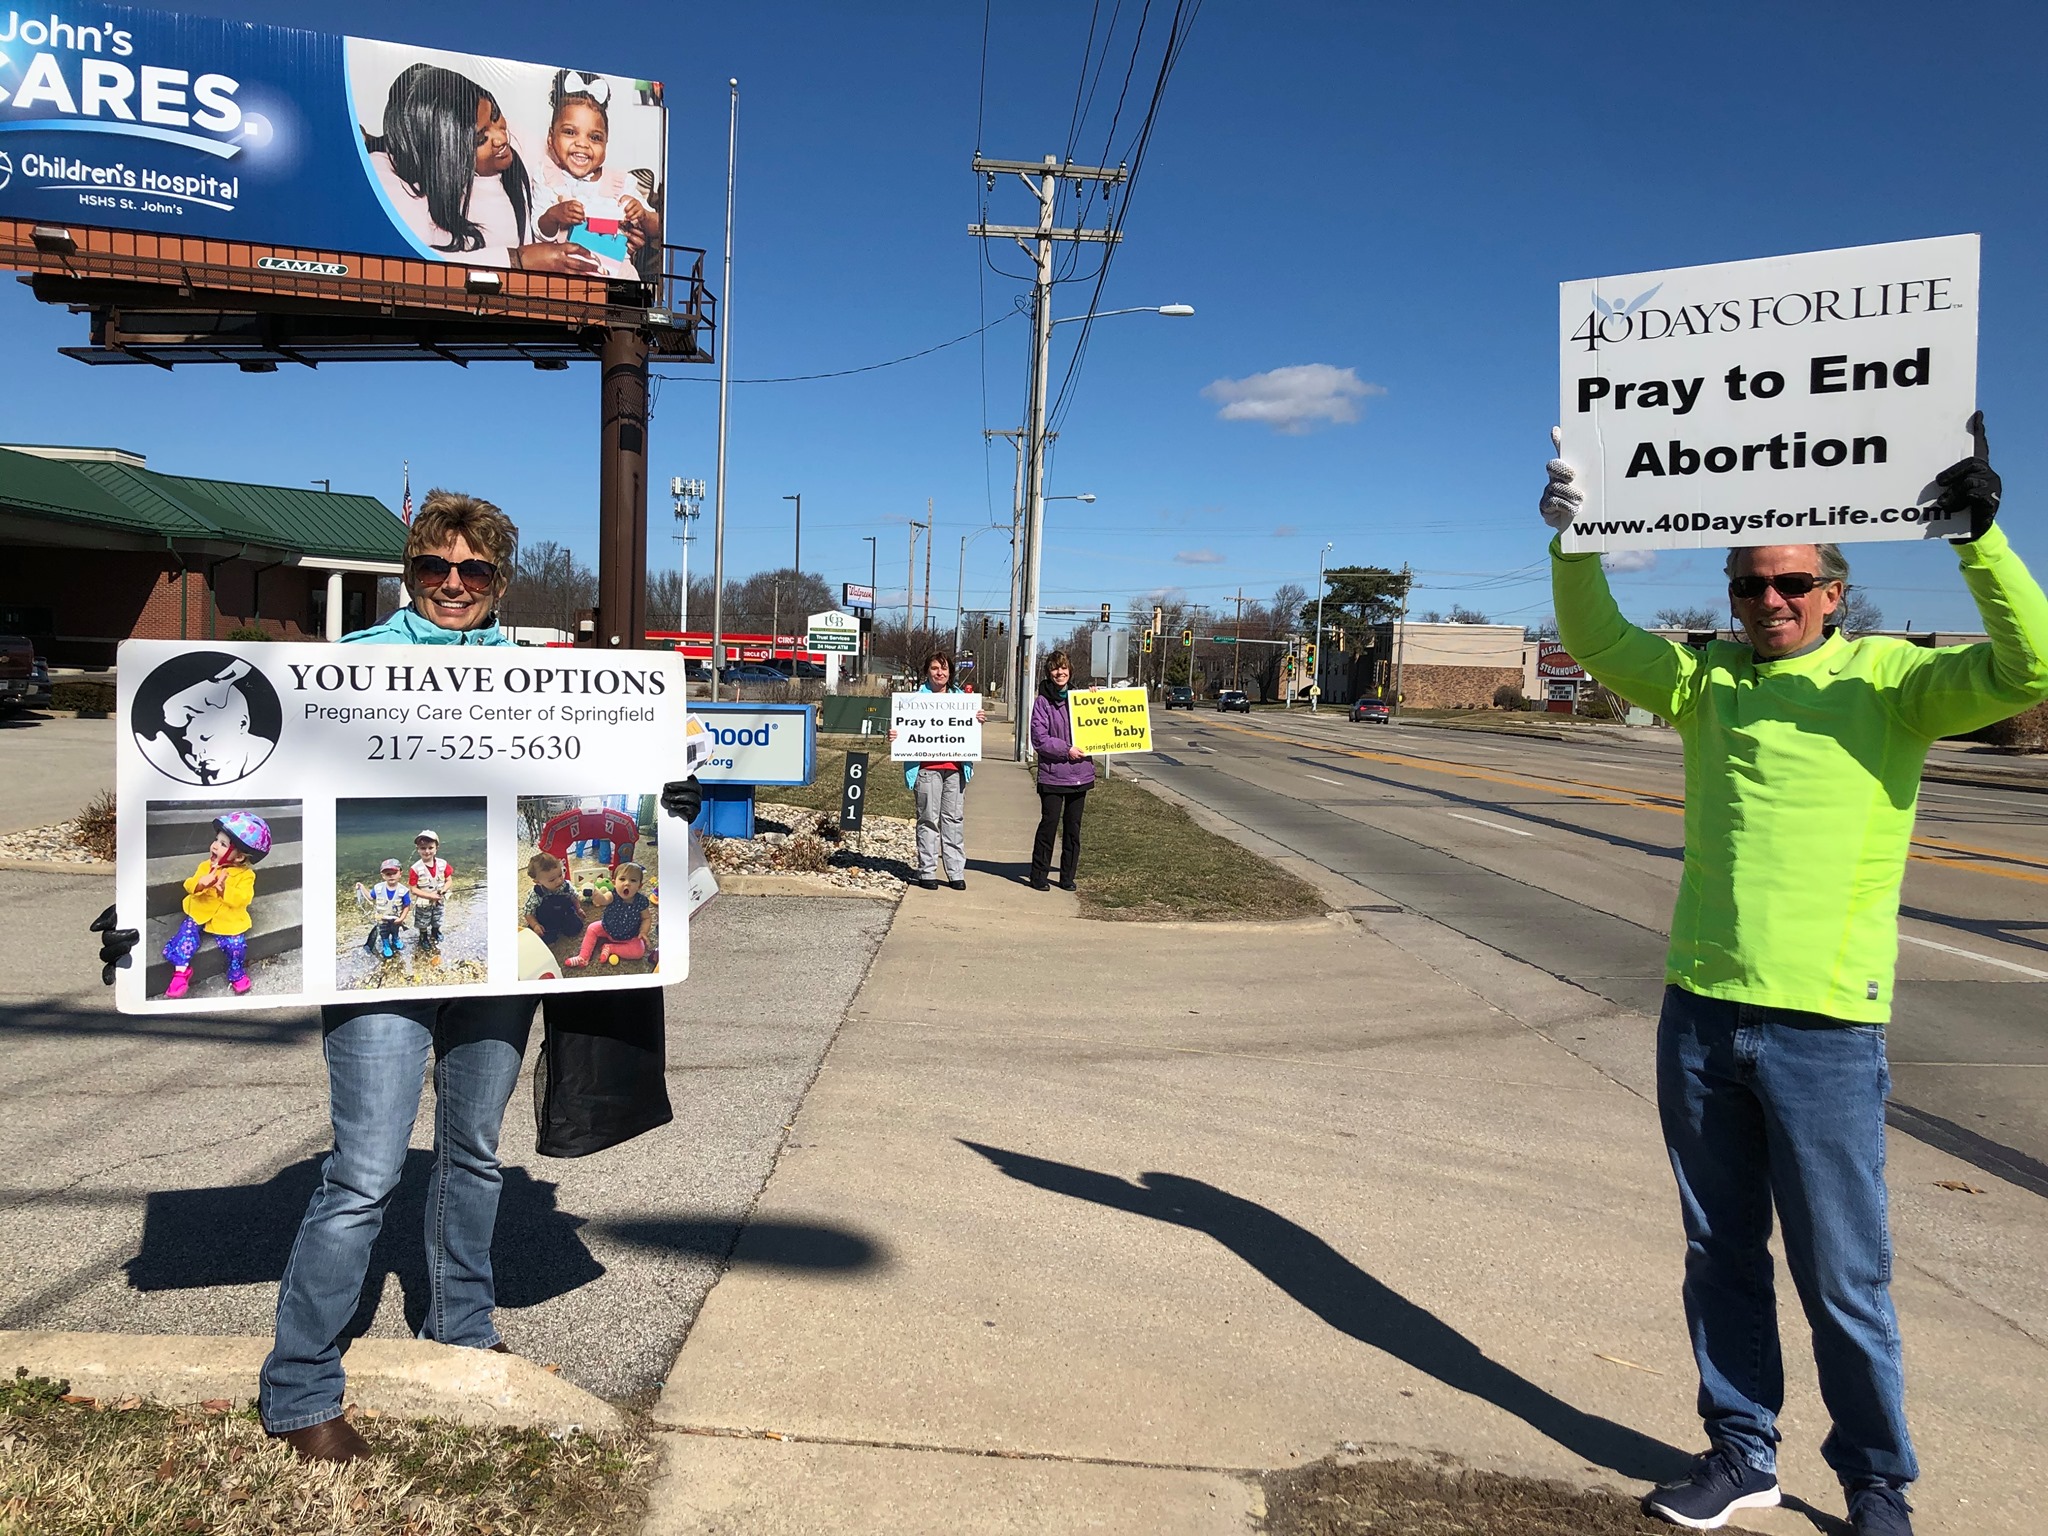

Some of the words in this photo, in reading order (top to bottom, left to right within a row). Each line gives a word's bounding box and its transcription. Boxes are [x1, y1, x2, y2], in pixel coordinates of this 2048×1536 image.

[0, 50, 258, 135] ARES.
[21, 153, 136, 187] Children's
[142, 169, 238, 200] Hospital
[79, 193, 116, 208] HSHS
[119, 198, 137, 210] St.
[140, 200, 183, 215] John's
[265, 258, 340, 274] LAMAR
[1578, 376, 1705, 415] Pray
[1724, 364, 1785, 401] to
[1809, 346, 1931, 394] End
[1624, 431, 1888, 478] Abortion
[1572, 505, 1952, 536] www.40DaysforLife.com
[777, 636, 802, 645] CIRCE
[1540, 662, 1583, 676] STEAKHOUSE
[288, 664, 375, 691] YOU
[385, 666, 494, 692] HAVE
[504, 667, 666, 695] OPTIONS
[1073, 695, 1105, 706] Love
[1097, 704, 1144, 714] woman
[304, 703, 410, 723] Pregnancy
[416, 704, 462, 720] Care
[469, 704, 532, 720] Center
[538, 705, 555, 721] of
[561, 705, 654, 725] Springfield
[896, 717, 926, 728] Pray
[930, 718, 944, 726] to
[948, 717, 972, 726] End
[1077, 716, 1108, 727] Love
[704, 722, 769, 746] hood
[907, 734, 965, 744] Abortion
[1114, 725, 1145, 738] baby
[367, 735, 581, 760] 217-525-5630
[1085, 742, 1142, 752] springfieldrtl.org
